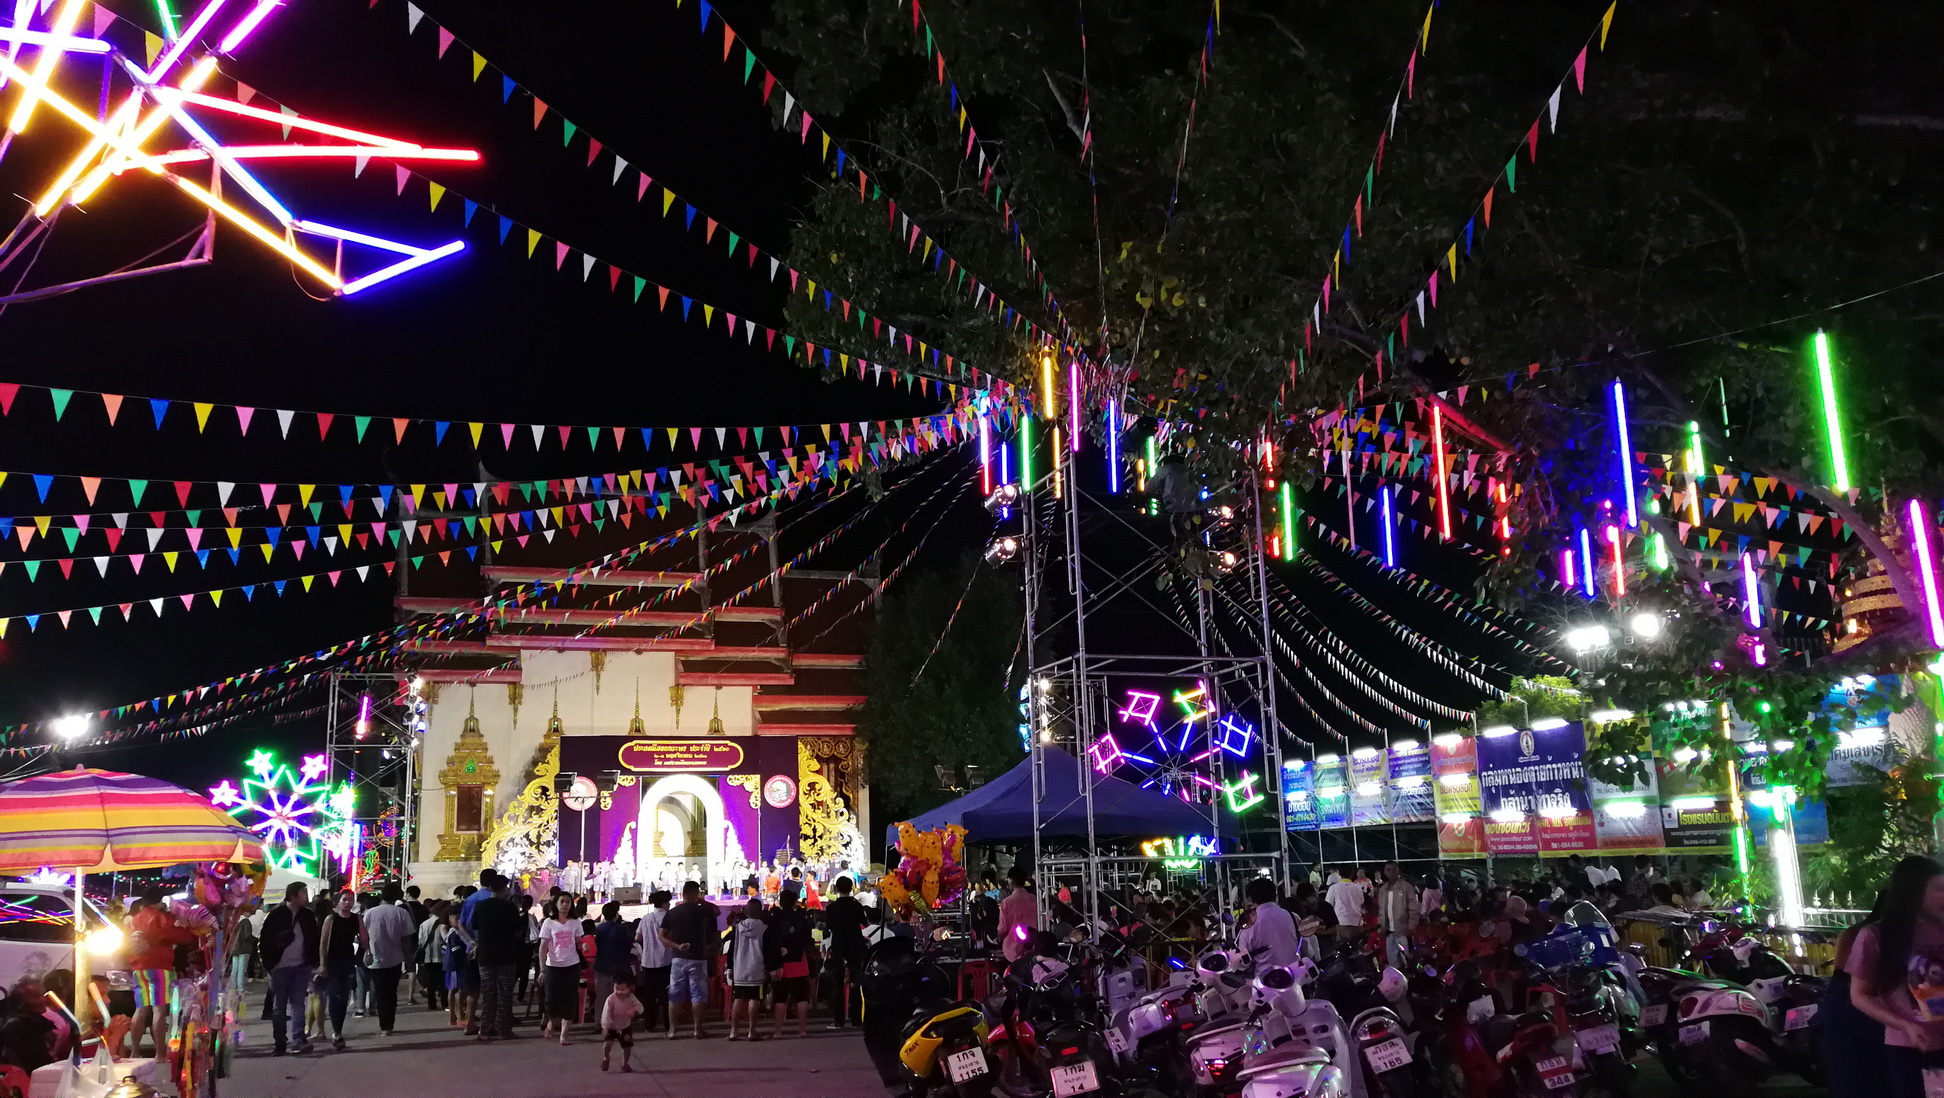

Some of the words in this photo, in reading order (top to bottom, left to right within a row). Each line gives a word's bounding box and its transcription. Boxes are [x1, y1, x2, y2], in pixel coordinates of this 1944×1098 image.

[1481, 753, 1585, 794] กลุ่มหนองคายก้าวหน้า
[956, 1050, 976, 1062] 1กจ
[959, 1066, 984, 1080] 1155
[1071, 1083, 1085, 1092] 14
